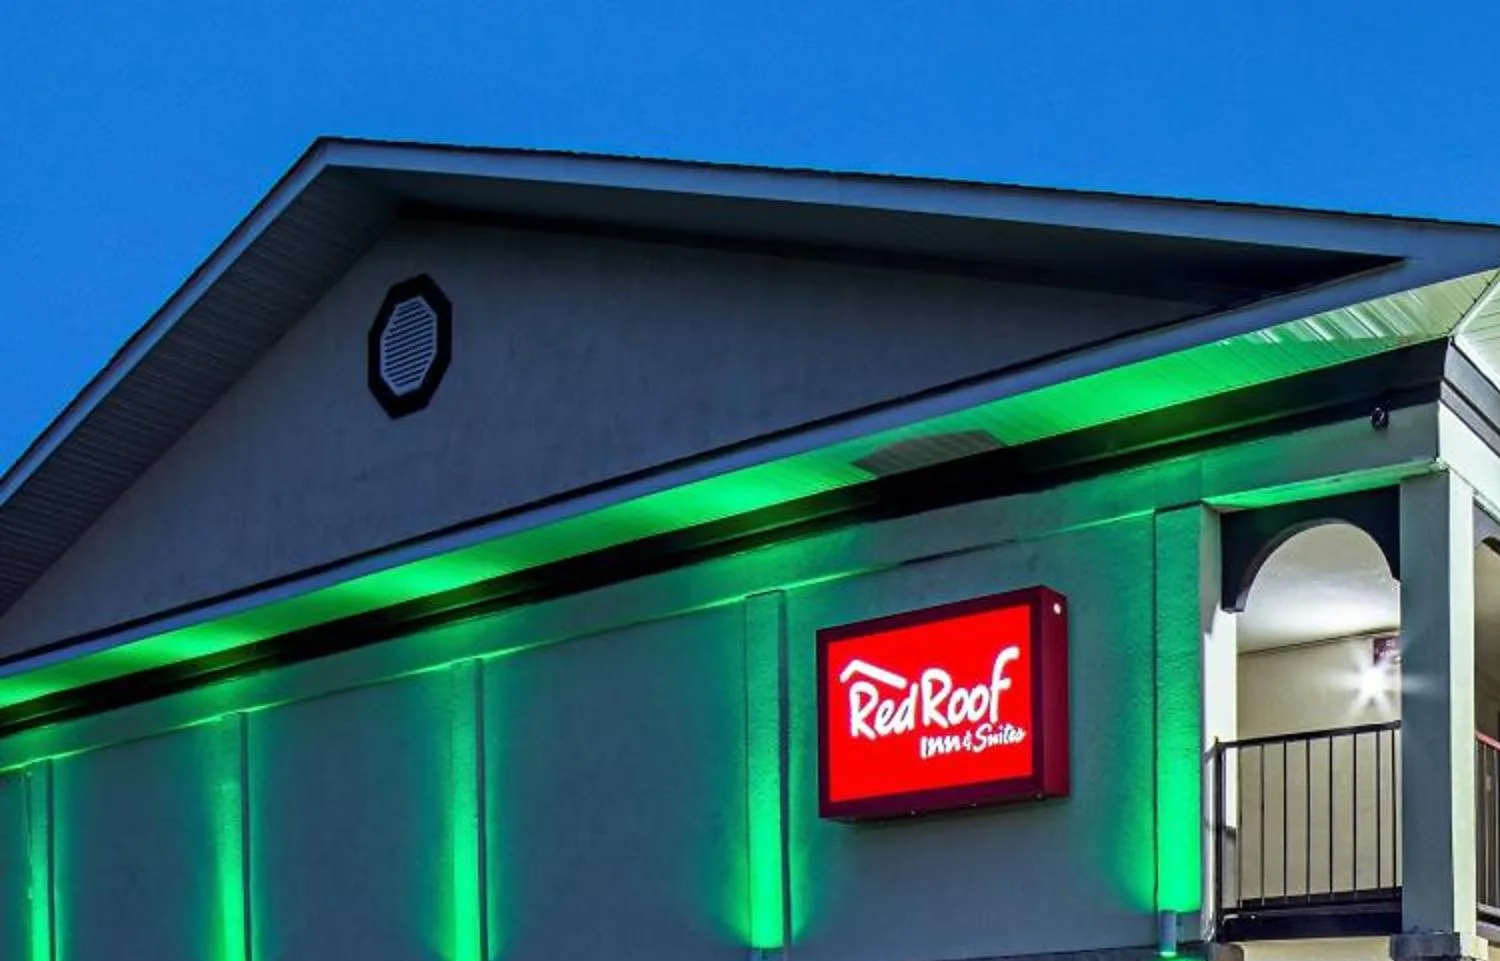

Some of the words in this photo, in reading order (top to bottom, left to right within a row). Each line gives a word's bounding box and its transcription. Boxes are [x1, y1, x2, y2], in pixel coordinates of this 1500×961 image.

[849, 681, 918, 740] Red
[921, 645, 1020, 728] Roof
[973, 722, 1026, 753] Suites
